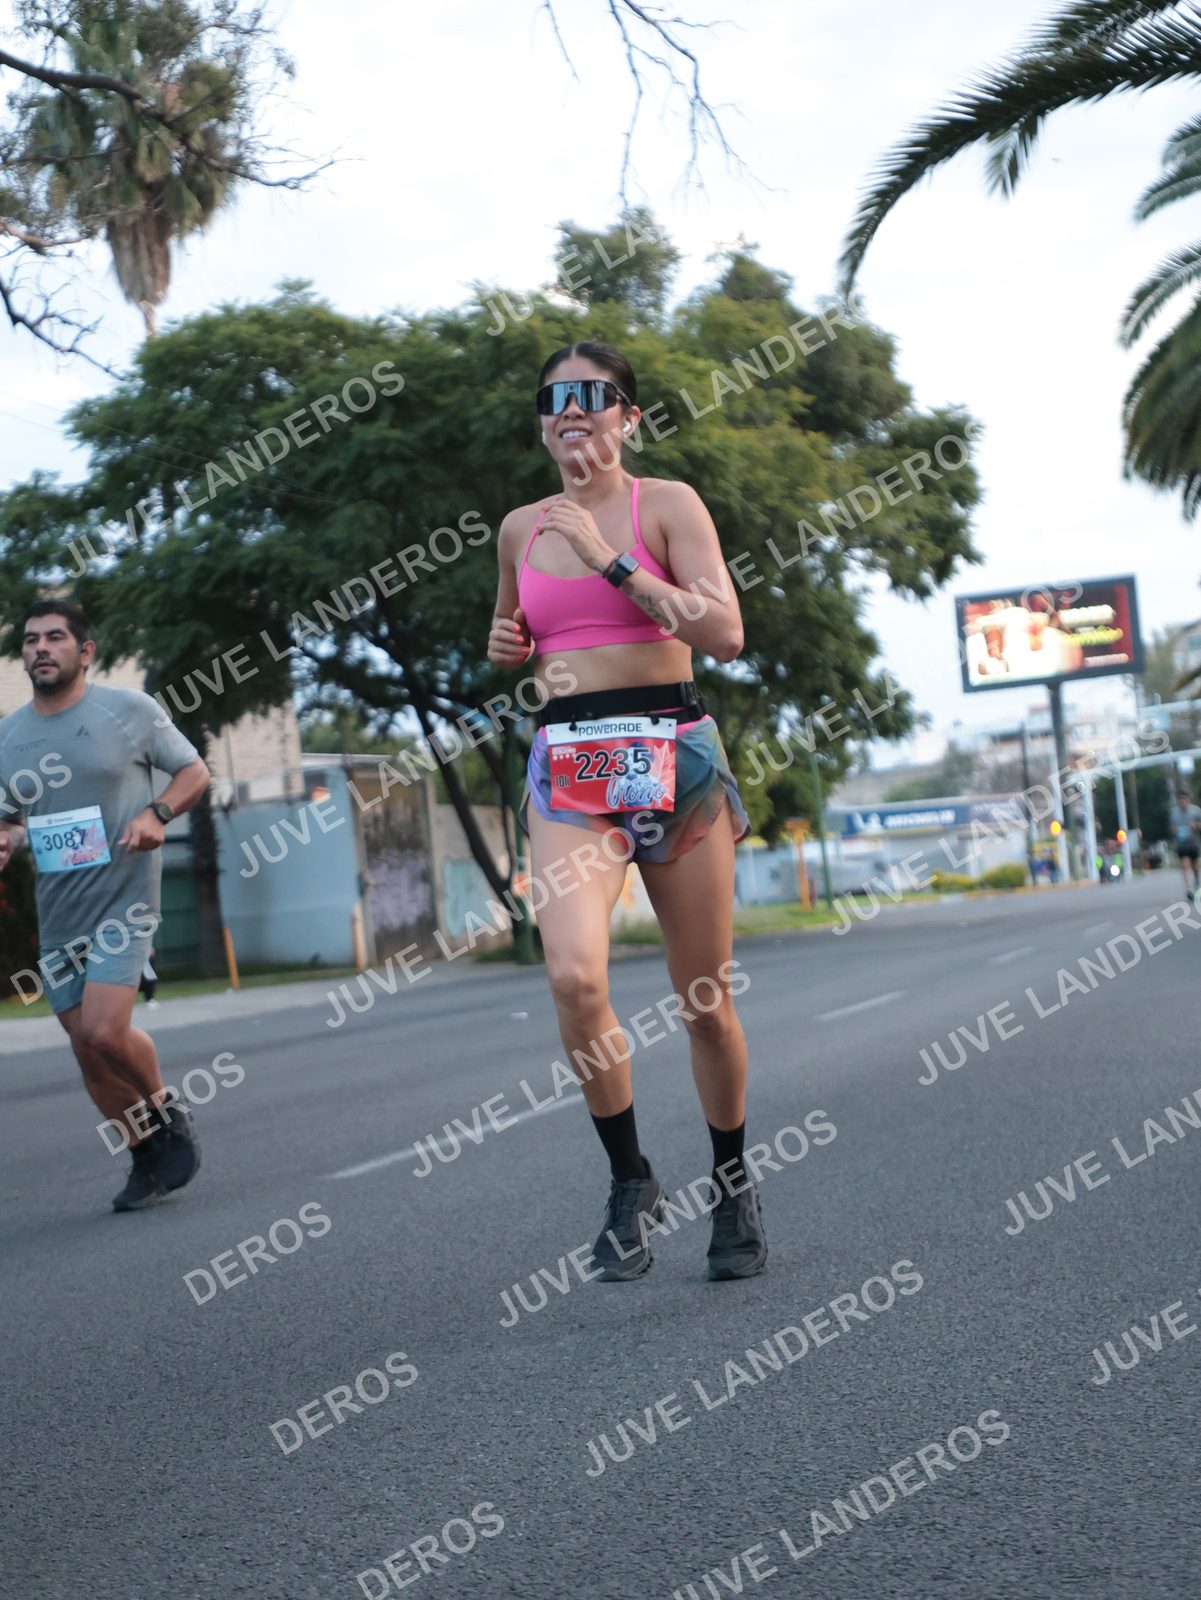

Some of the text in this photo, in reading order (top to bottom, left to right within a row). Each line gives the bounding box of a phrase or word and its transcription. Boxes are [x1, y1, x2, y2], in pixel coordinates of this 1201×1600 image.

[578, 723, 642, 736] POWERADE
[575, 748, 651, 782] 2235
[42, 829, 86, 851] 3087
